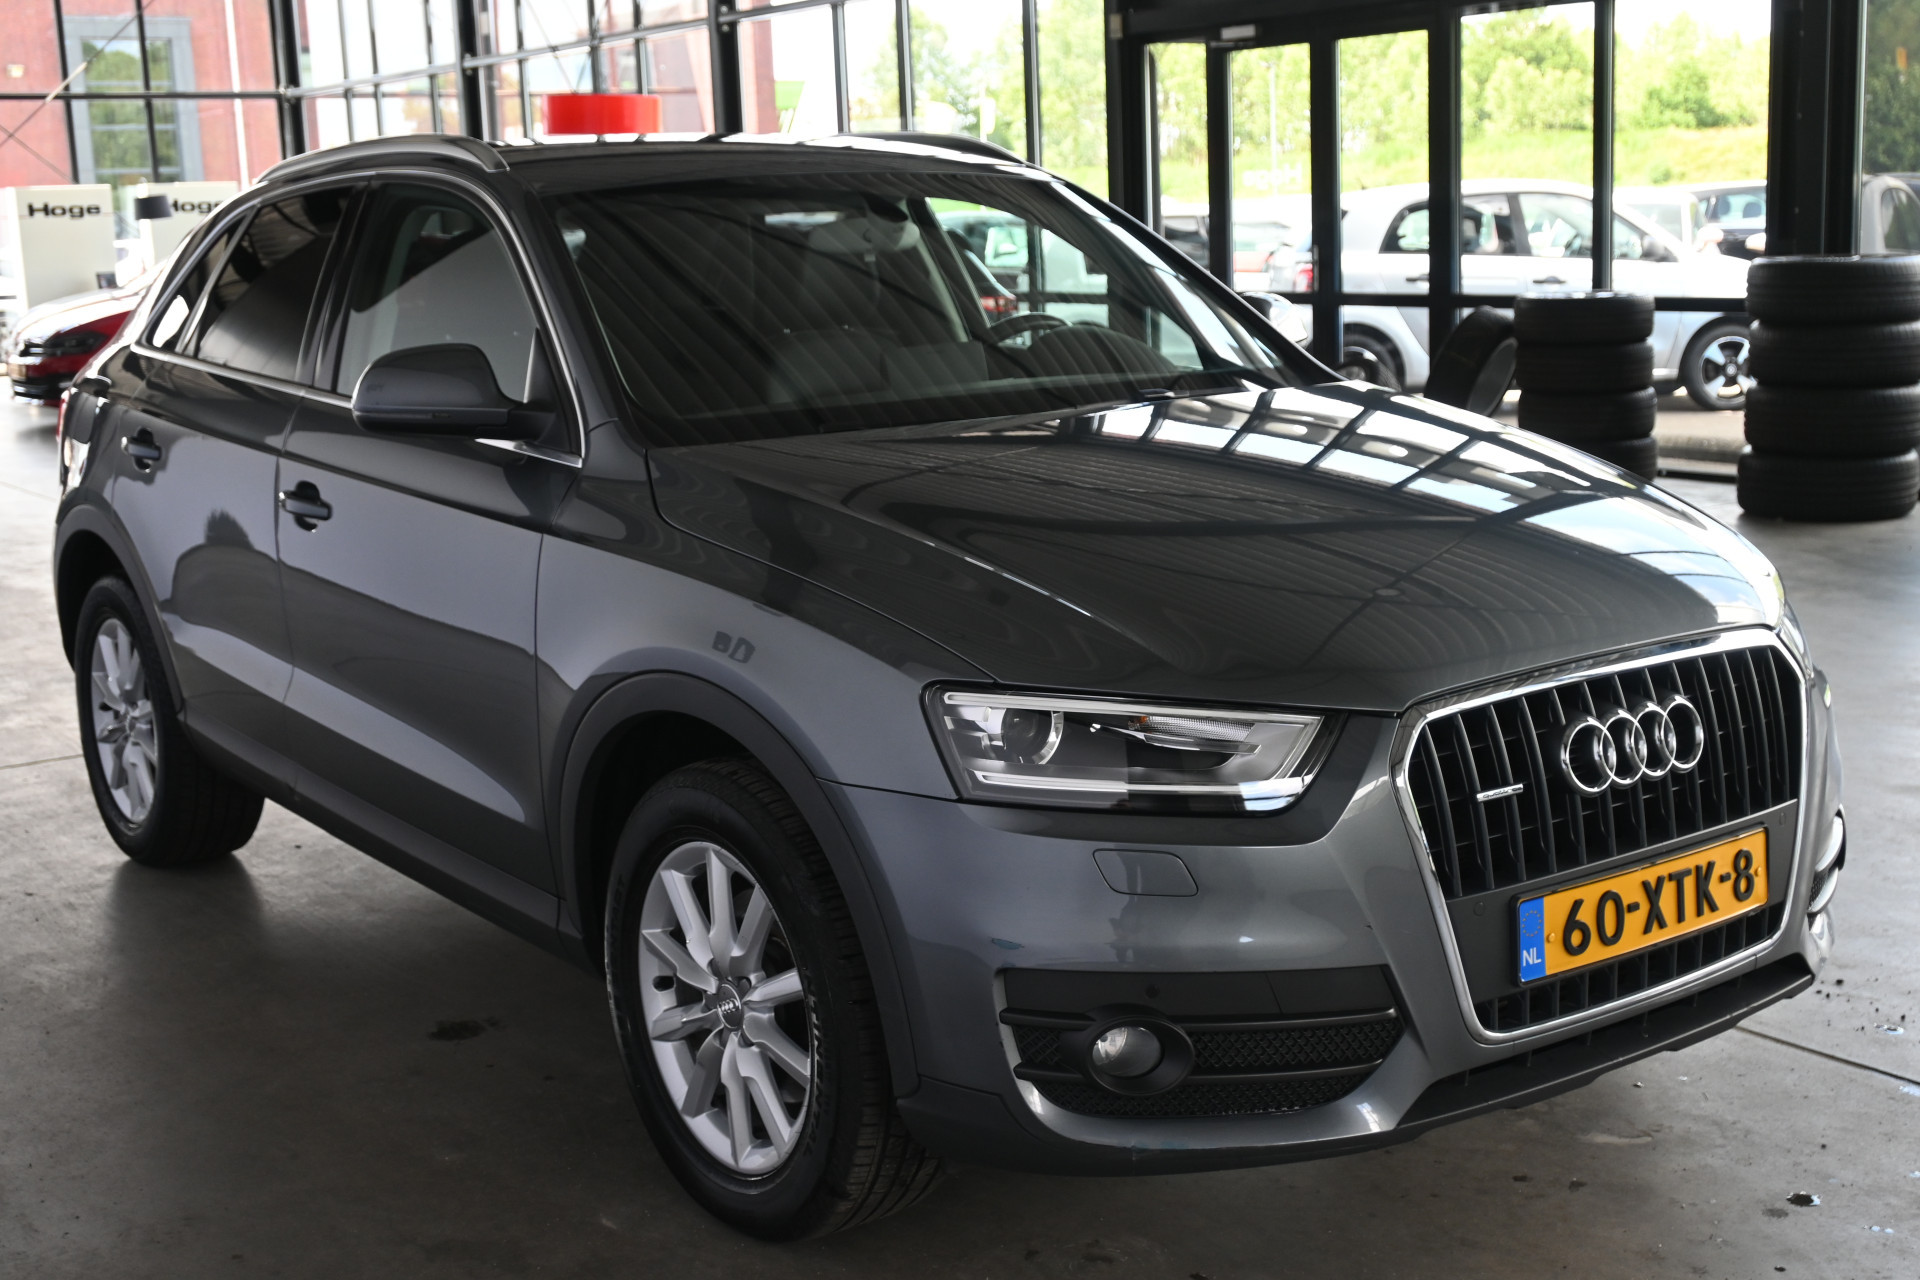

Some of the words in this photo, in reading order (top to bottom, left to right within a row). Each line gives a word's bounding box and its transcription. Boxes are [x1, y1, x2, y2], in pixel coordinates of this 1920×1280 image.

[28, 202, 101, 218] Hoge
[172, 198, 221, 214] og
[1562, 848, 1756, 957] 60-XTK-8
[1522, 946, 1542, 967] NL
